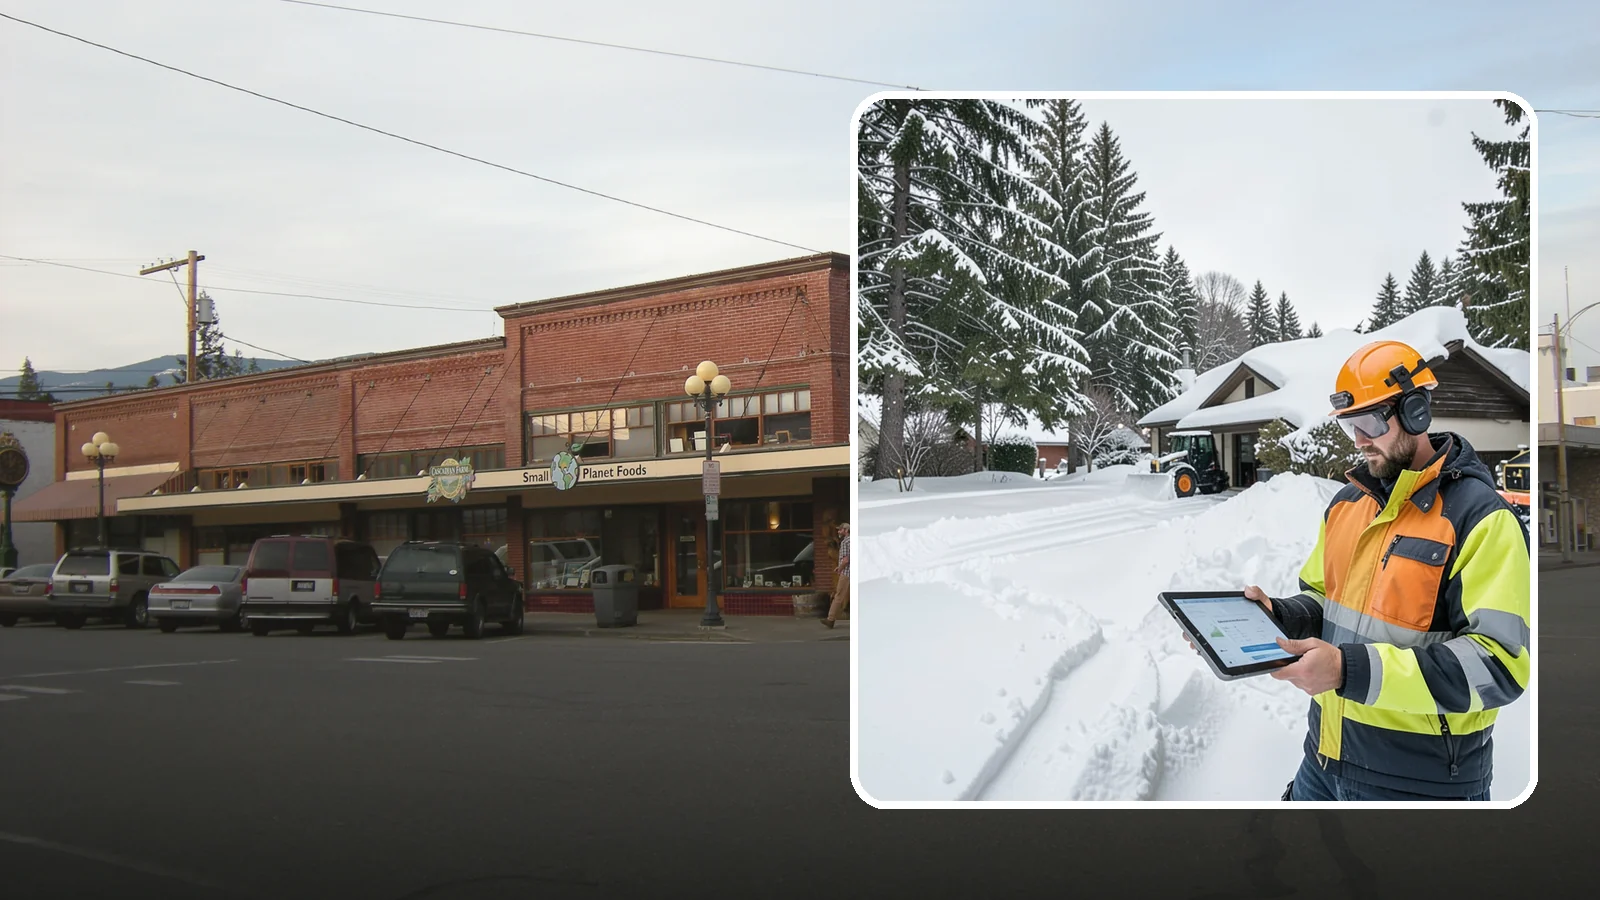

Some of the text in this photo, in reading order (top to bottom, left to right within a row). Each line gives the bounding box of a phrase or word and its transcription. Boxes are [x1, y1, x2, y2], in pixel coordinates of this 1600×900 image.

[523, 464, 646, 482] Small Planet Foods
